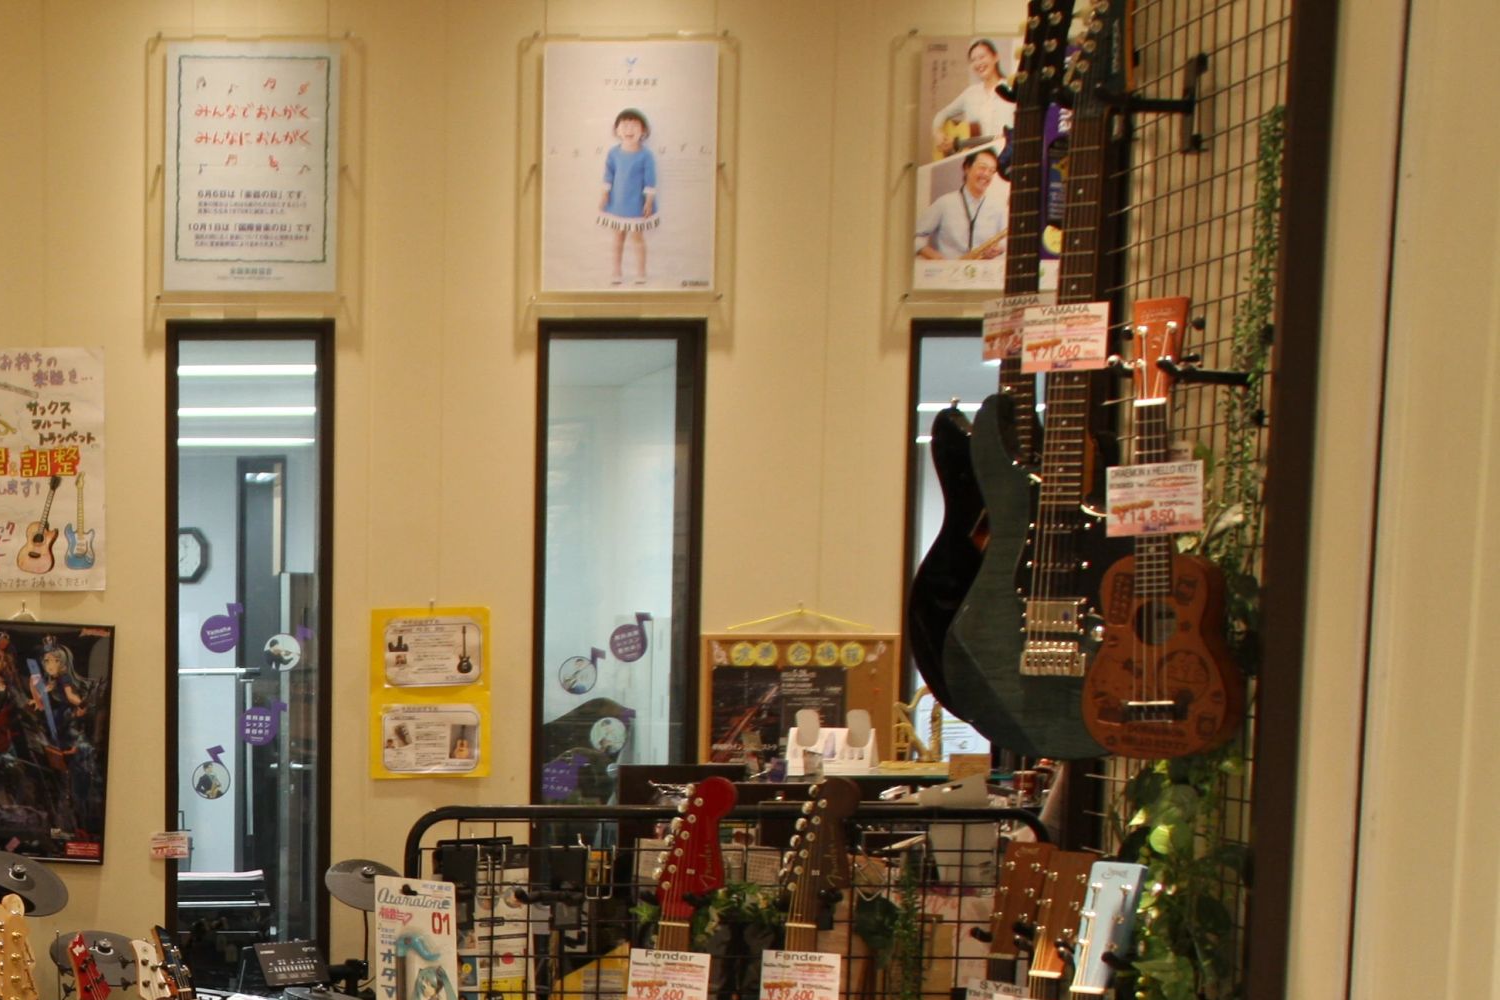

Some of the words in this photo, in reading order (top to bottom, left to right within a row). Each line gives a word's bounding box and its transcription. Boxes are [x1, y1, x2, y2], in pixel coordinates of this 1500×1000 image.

[195, 103, 254, 119] みんなで
[256, 103, 309, 120] おんがく
[195, 131, 251, 146] みんなに
[256, 130, 311, 145] おんがく
[996, 296, 1040, 306] YAMAHA
[1040, 304, 1090, 316] YAMAHA
[0, 352, 57, 372] お持ちの
[26, 401, 71, 416] サックス
[39, 432, 95, 446] トランペット
[431, 911, 451, 935] 01
[644, 950, 694, 961] Fender
[775, 951, 824, 962] Fender
